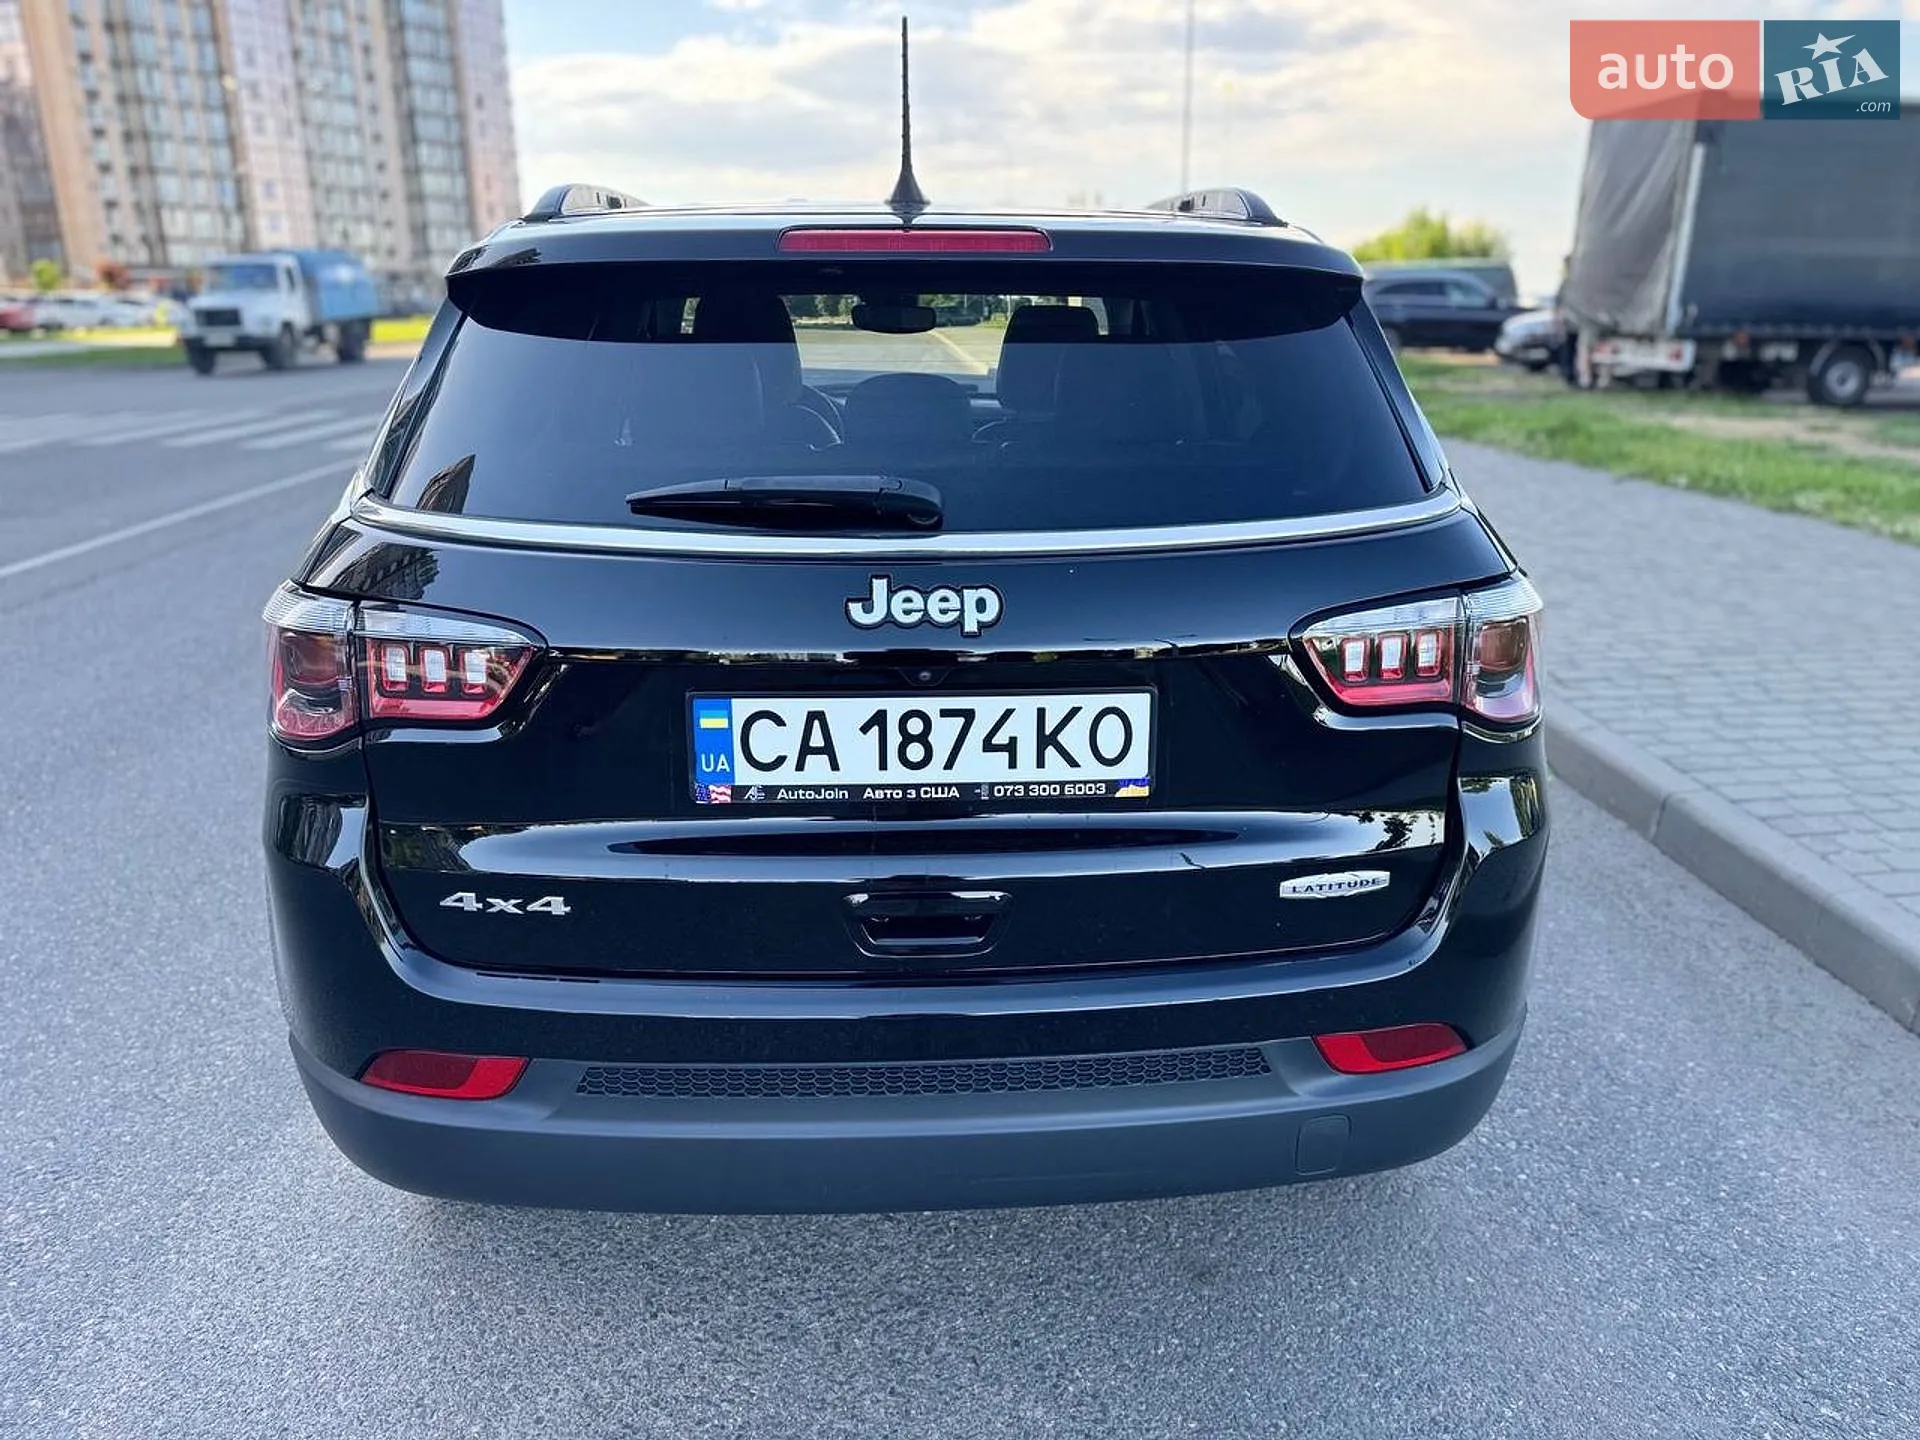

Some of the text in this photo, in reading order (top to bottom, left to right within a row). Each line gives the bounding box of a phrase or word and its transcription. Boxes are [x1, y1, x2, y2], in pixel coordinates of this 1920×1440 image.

[848, 577, 1000, 632] Jeep
[740, 710, 840, 772] CA
[859, 708, 1018, 770] 1874
[701, 753, 731, 773] UA
[776, 788, 849, 800] AutoJoin
[920, 786, 960, 799] США
[994, 785, 1025, 797] 073
[1028, 784, 1060, 796] 300
[1064, 783, 1107, 795] 6003
[1292, 878, 1381, 893] LATITUDE
[439, 891, 572, 916] 4x4
